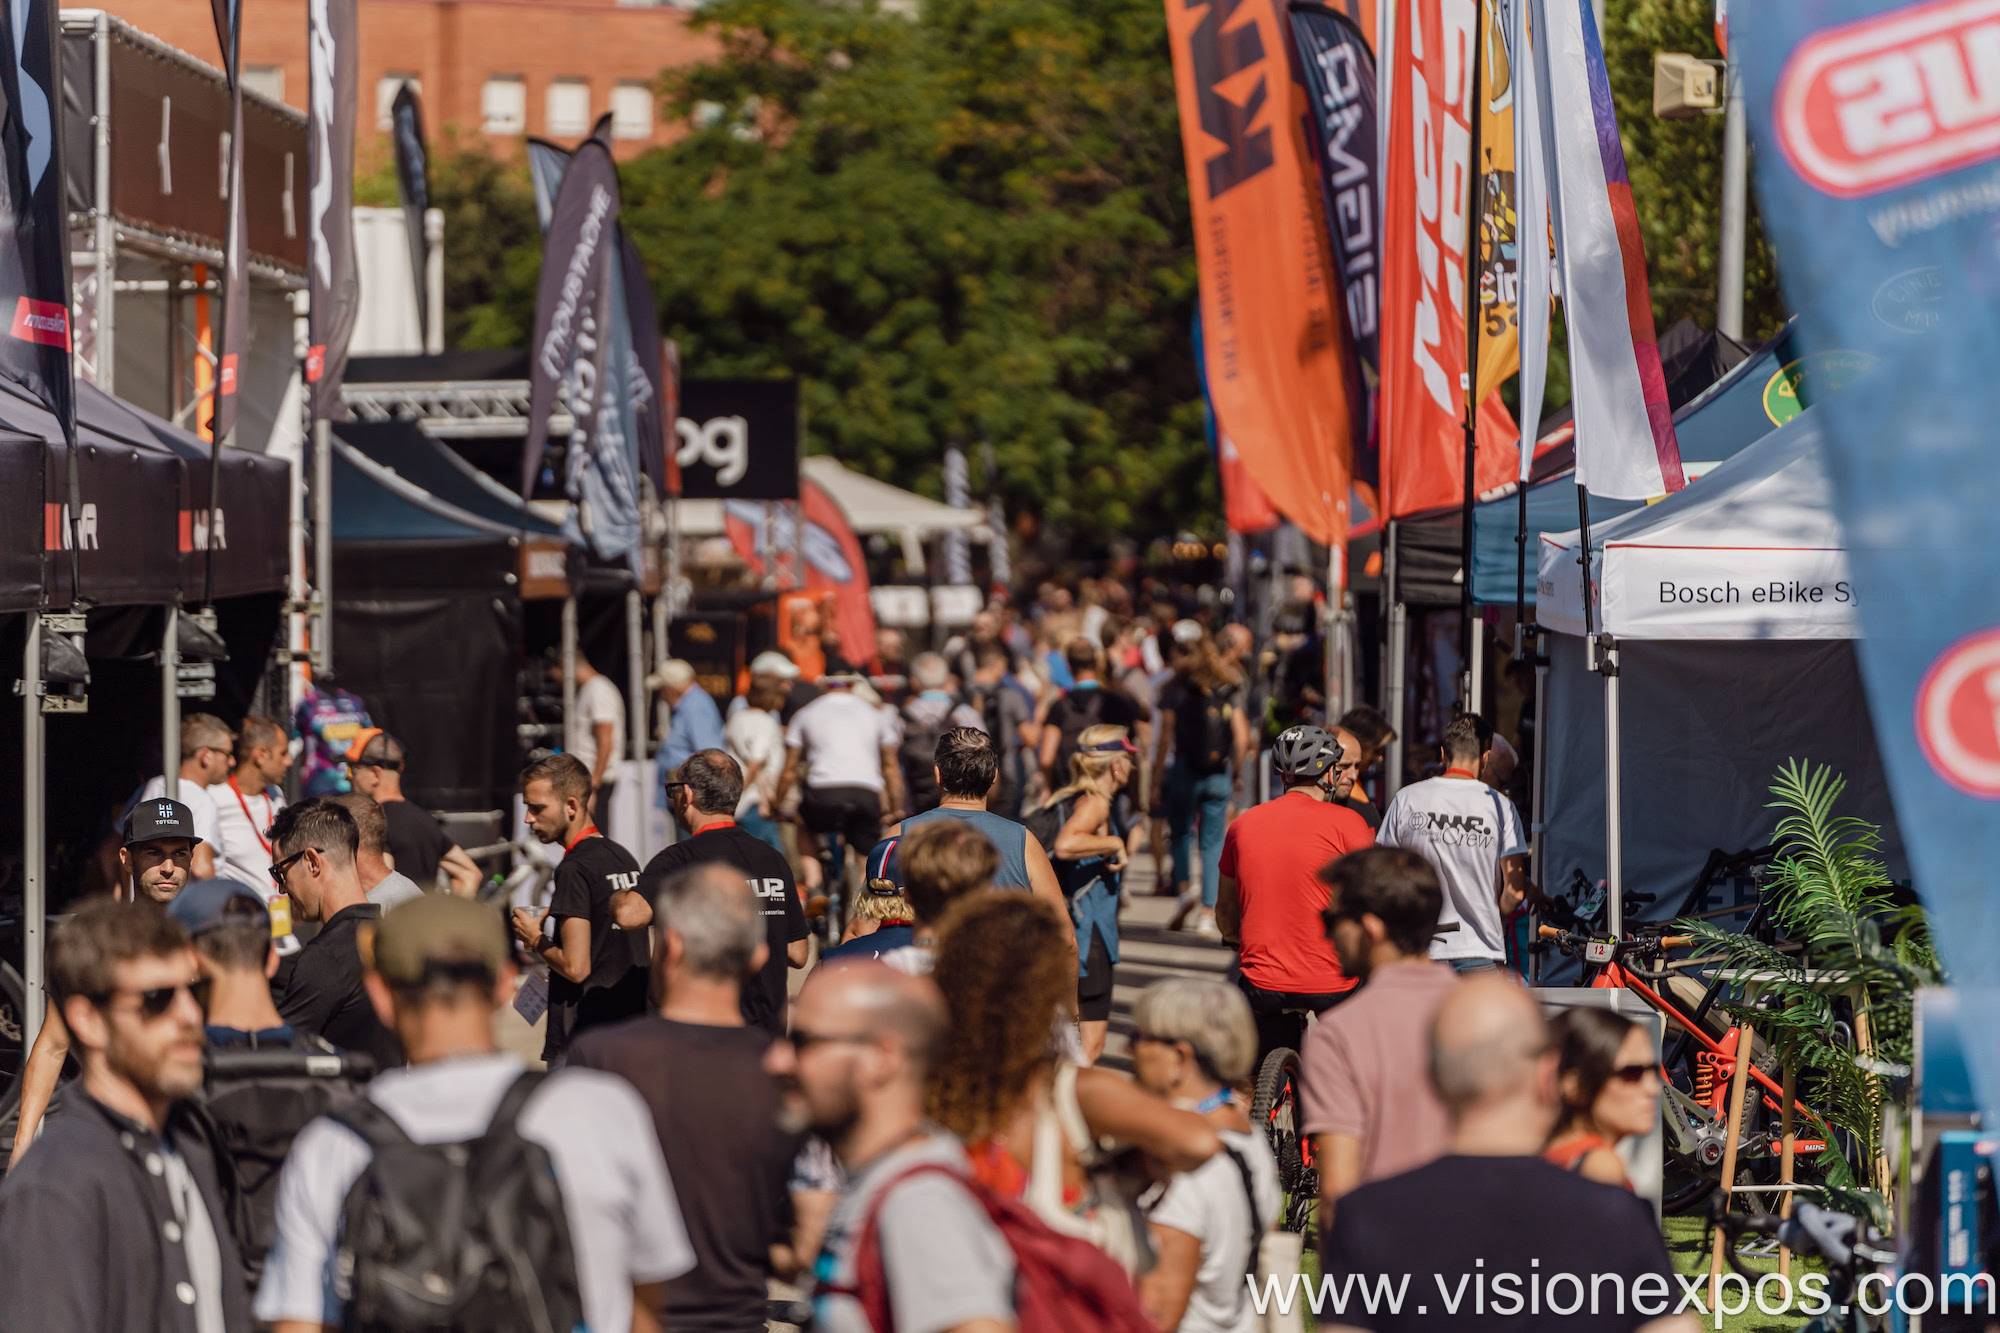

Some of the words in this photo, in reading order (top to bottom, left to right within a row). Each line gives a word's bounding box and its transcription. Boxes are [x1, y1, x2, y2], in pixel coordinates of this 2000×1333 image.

[1658, 580, 1740, 604] Bosch
[1751, 580, 1823, 604] eBike
[1442, 827, 1495, 849] Crew
[1594, 944, 1605, 955] 12
[1662, 1084, 1686, 1132] ORBEA
